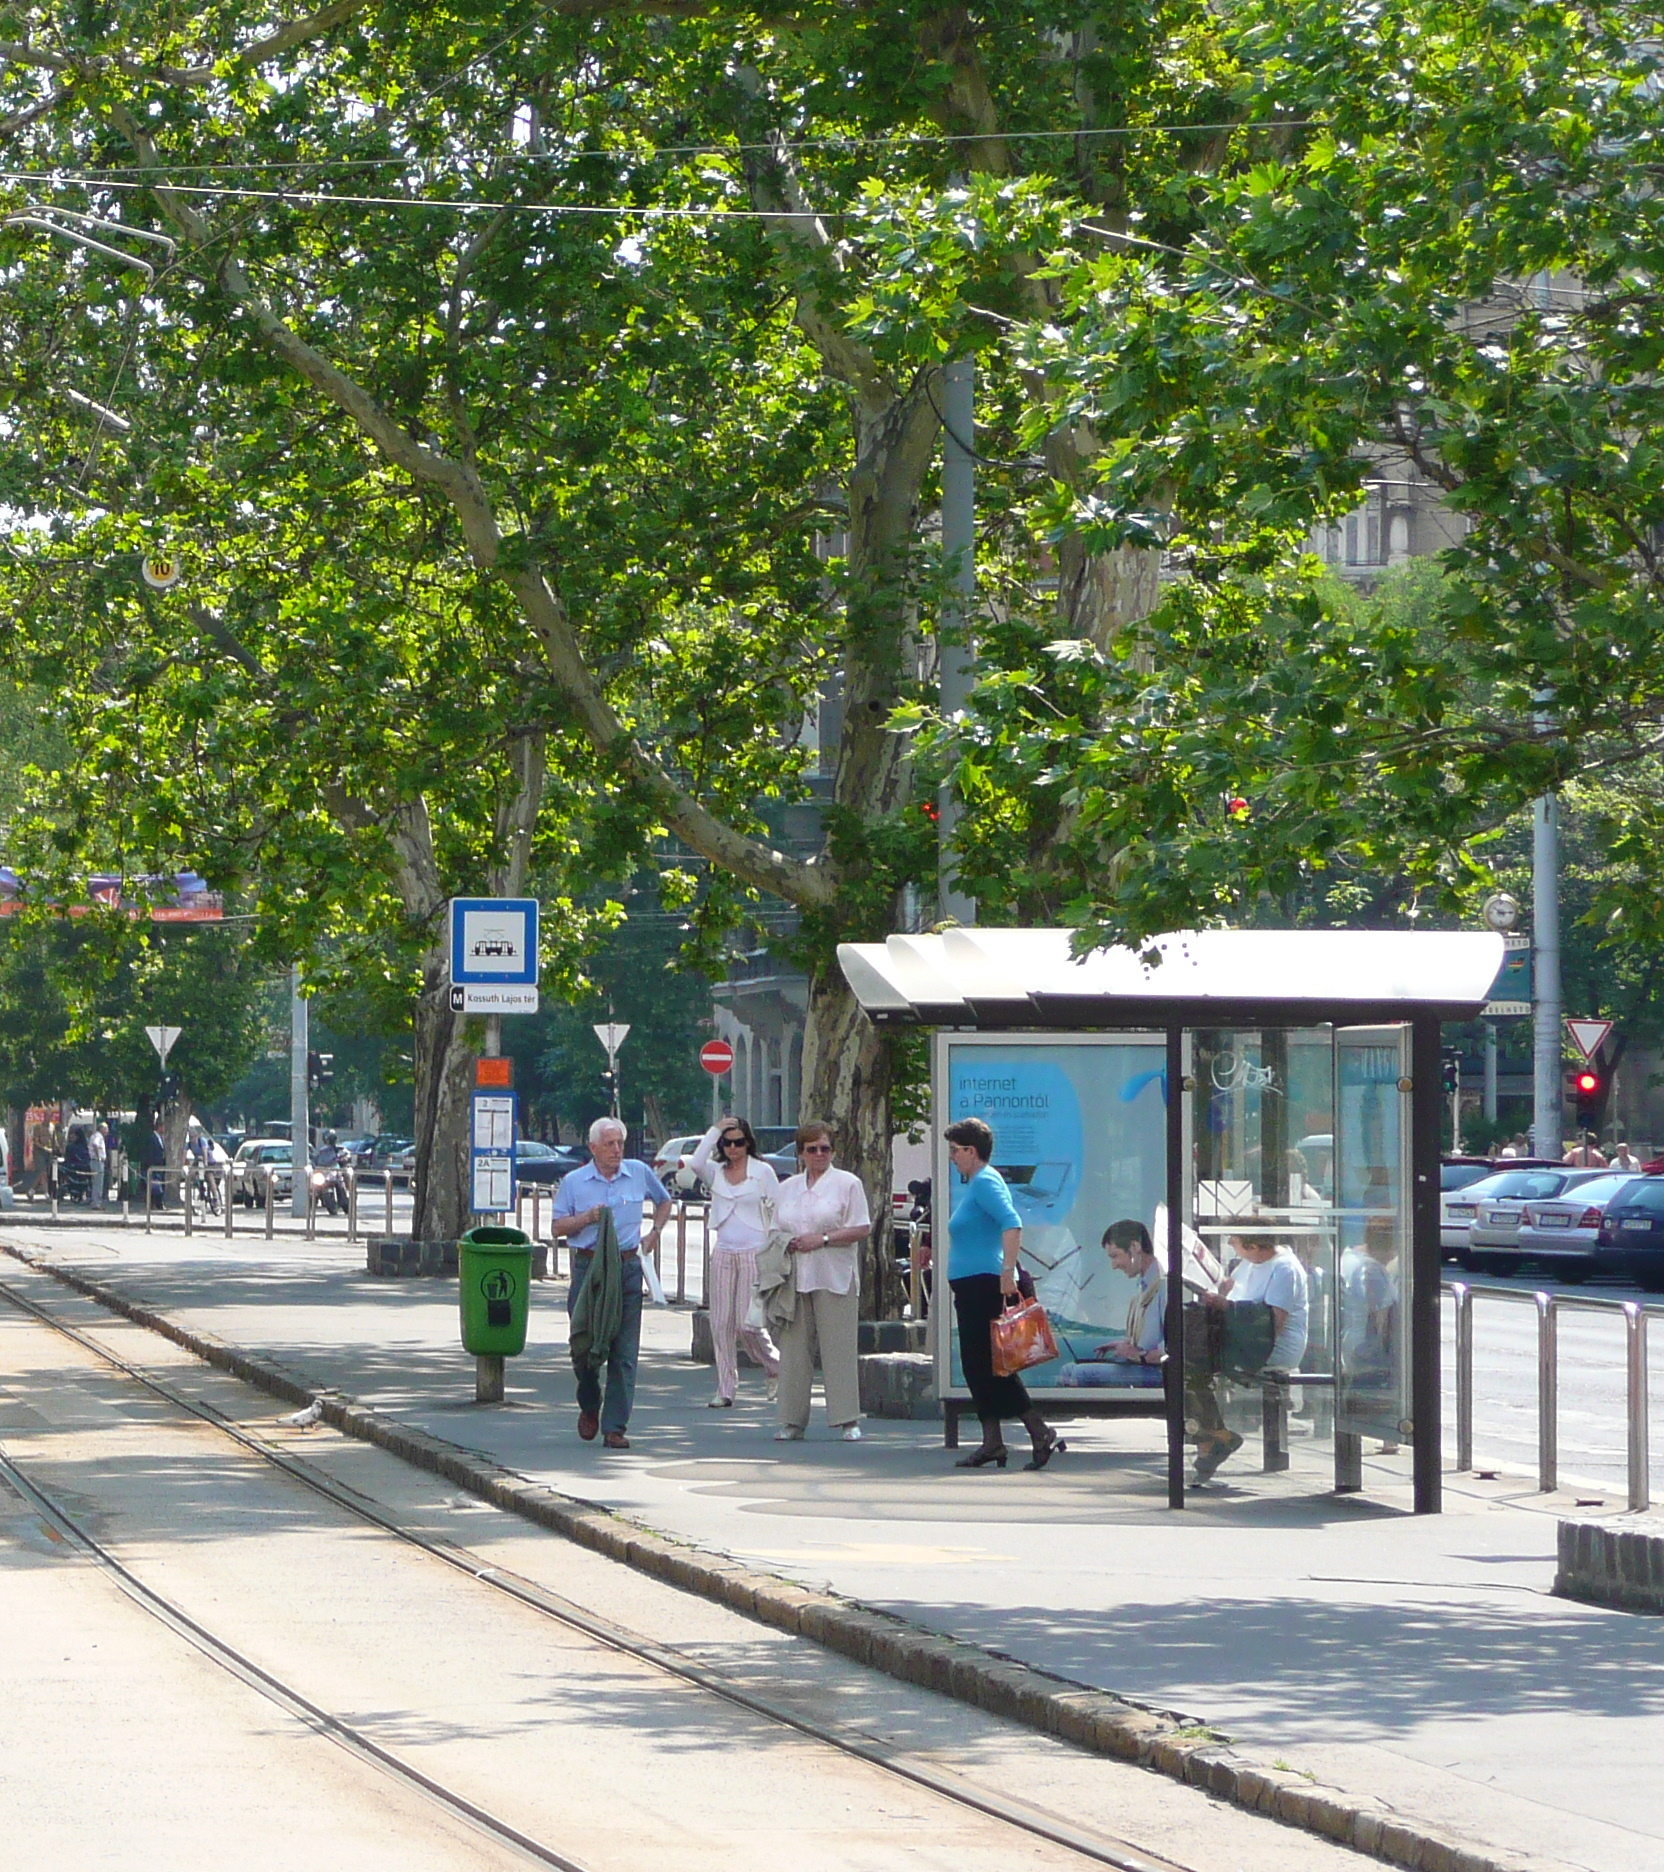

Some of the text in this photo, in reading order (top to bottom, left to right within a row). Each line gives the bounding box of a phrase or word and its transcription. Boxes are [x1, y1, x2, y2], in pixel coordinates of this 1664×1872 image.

[467, 993, 499, 1003] Kossuth
[501, 994, 522, 1005] Lajos
[959, 1076, 1017, 1091] internet
[960, 1092, 1049, 1109] a Pannontól
[477, 1159, 490, 1168] 2A
